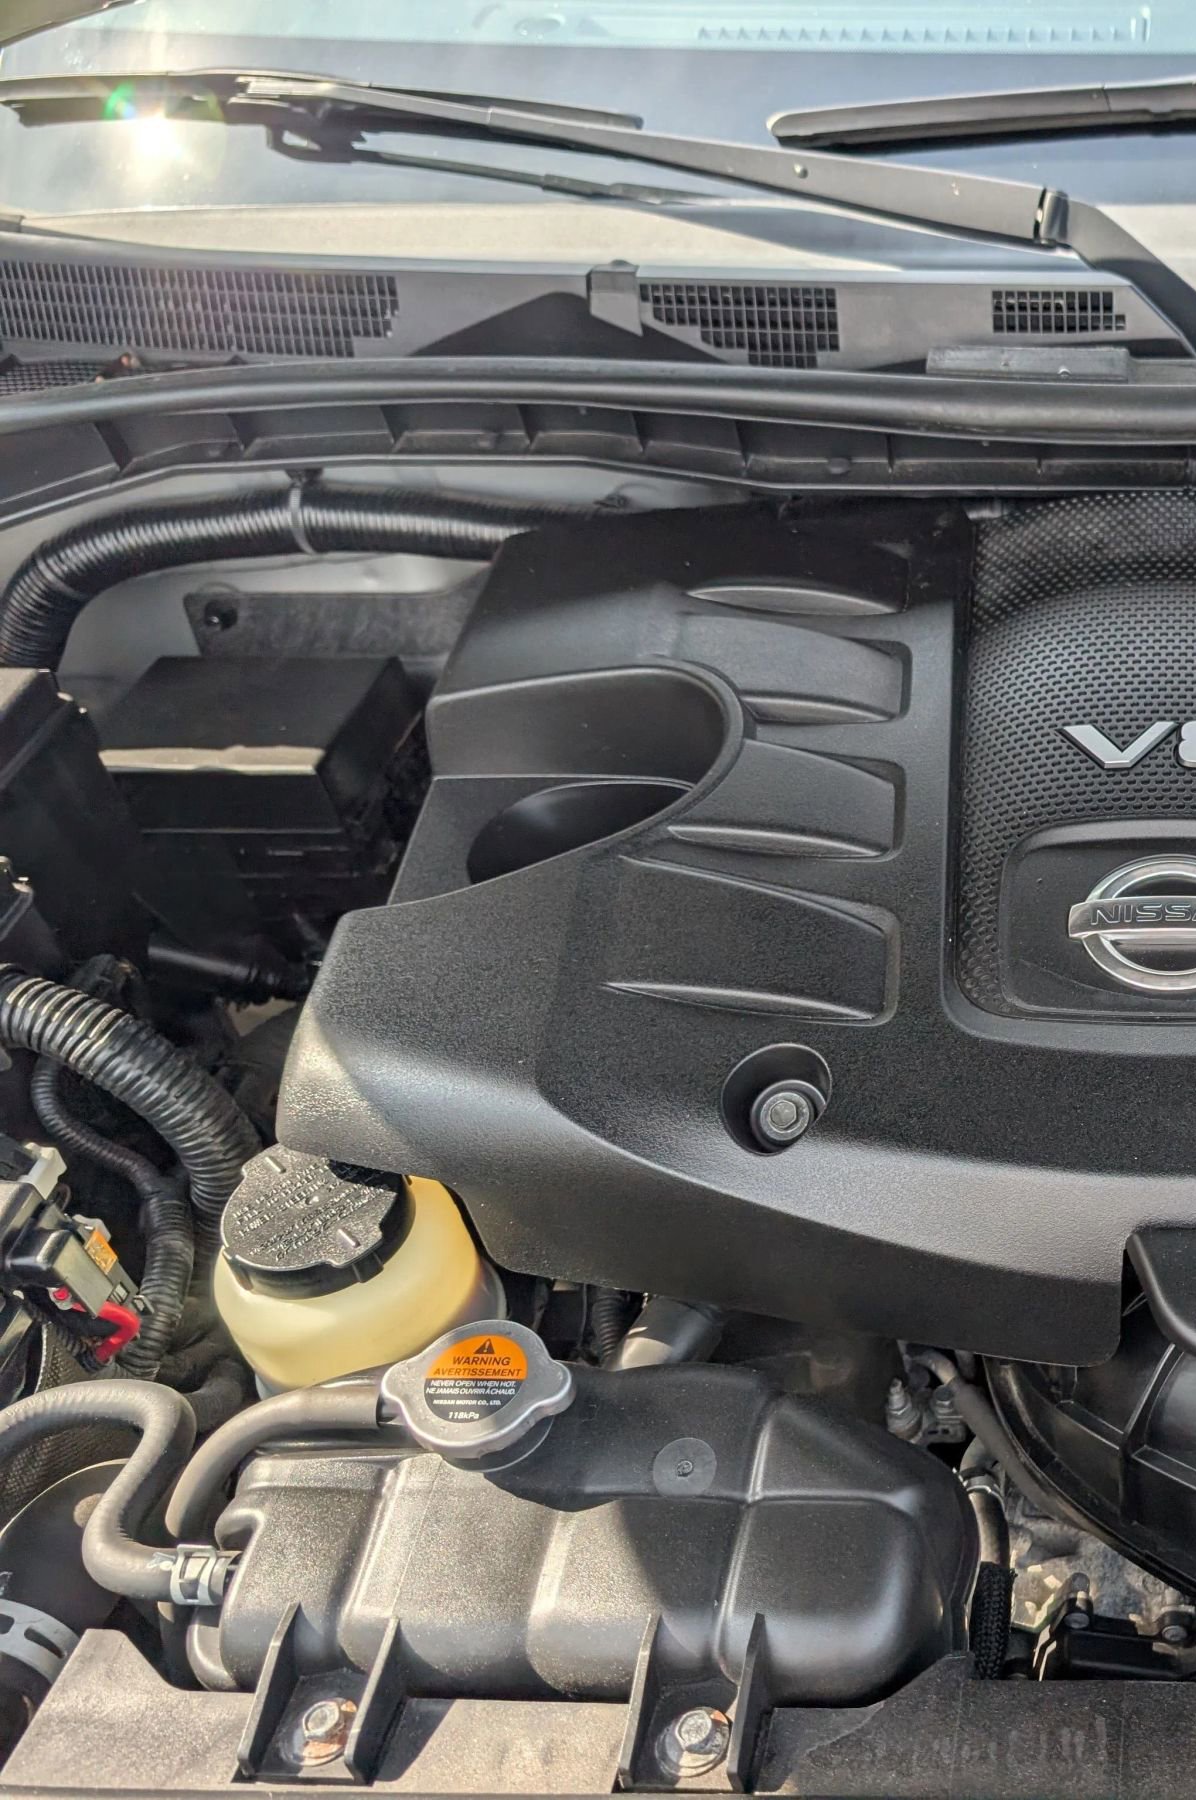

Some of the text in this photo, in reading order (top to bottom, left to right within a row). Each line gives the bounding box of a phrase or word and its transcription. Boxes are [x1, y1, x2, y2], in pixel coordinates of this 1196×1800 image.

[452, 1357, 511, 1366] WARNING
[433, 1368, 522, 1377] AVERTISSEMENT
[460, 1388, 485, 1396] OUVRIR
[491, 1388, 516, 1396] CHAUD.
[449, 1412, 480, 1420] 118kPa
